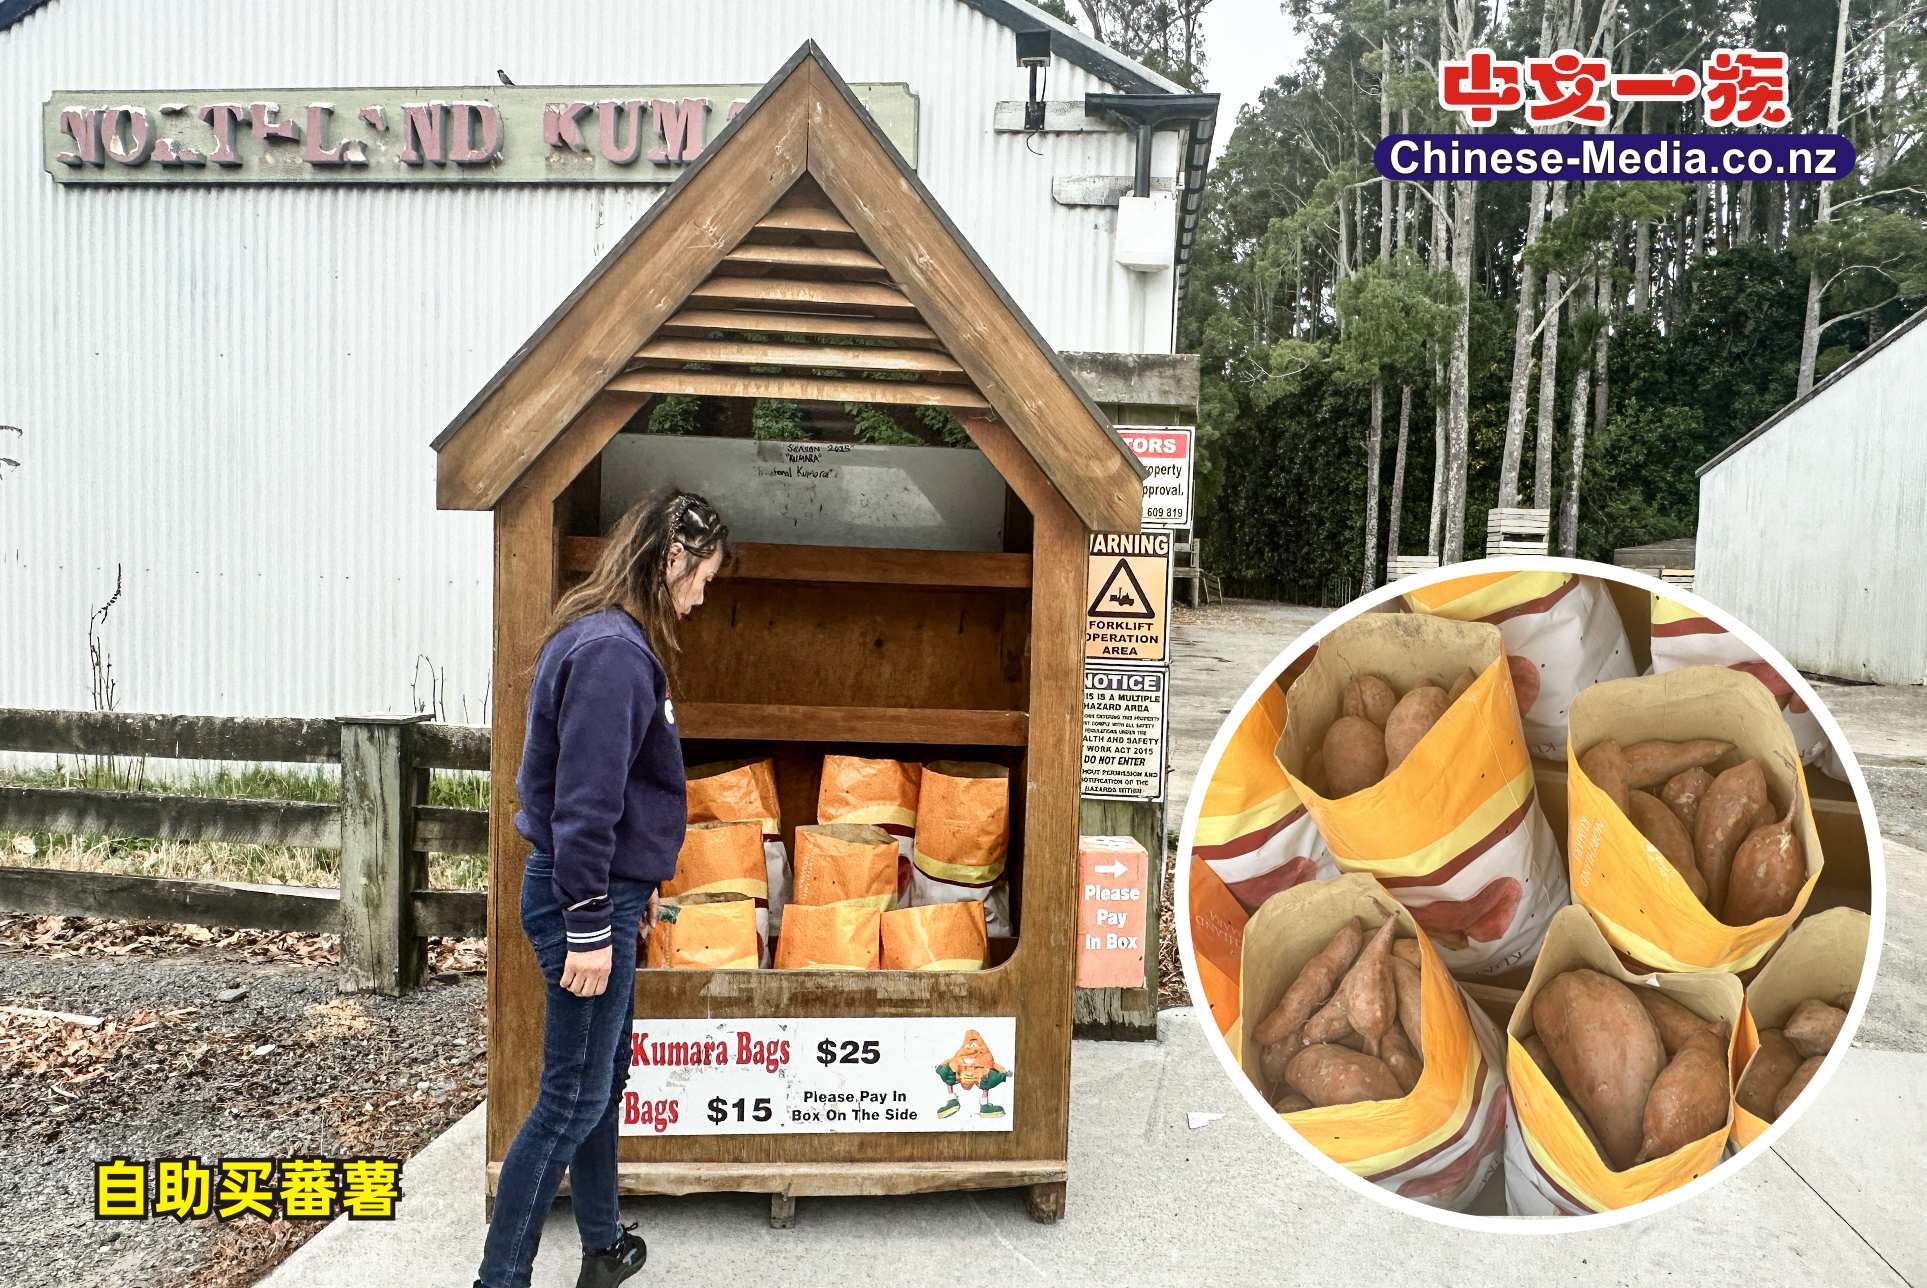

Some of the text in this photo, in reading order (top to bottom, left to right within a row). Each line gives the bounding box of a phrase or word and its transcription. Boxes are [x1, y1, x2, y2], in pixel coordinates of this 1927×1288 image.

[543, 97, 750, 166] KUM
[1147, 507, 1183, 518] 609 819
[1089, 533, 1169, 555] ARNING
[1089, 620, 1154, 631] FORKLIFT
[1102, 646, 1138, 655] AREA
[1118, 694, 1160, 702] MULTIPLE
[1114, 746, 1131, 754] ACT
[1084, 755, 1146, 767] DO NOT ENTER
[1084, 884, 1141, 901] Please
[1096, 908, 1128, 928] Pay
[1085, 932, 1138, 949] In Box
[632, 1031, 790, 1074] Kumara Bags
[816, 1038, 881, 1068] $25
[803, 1090, 907, 1105] Please Pay In
[623, 1091, 679, 1133] Bags
[707, 1096, 773, 1125] $15
[791, 1108, 918, 1121] Box On The Side
